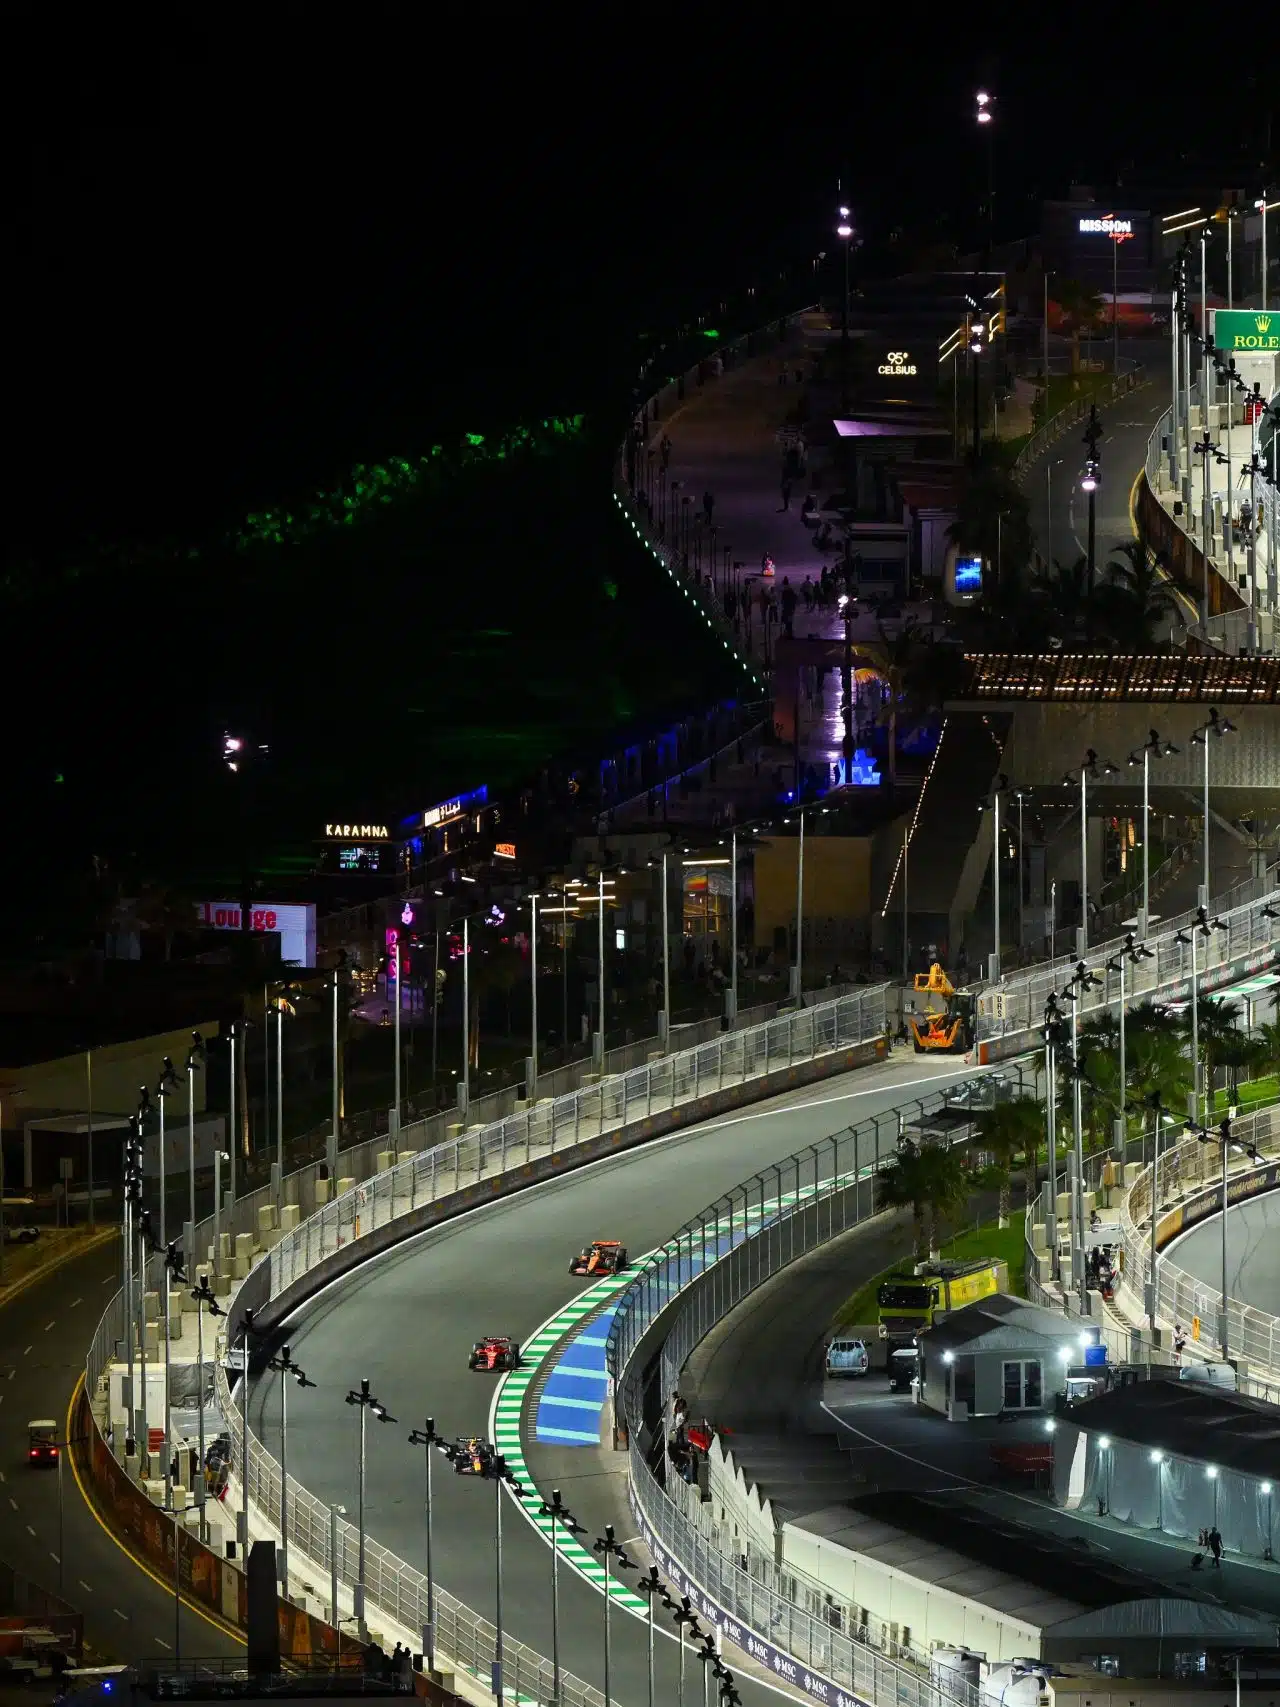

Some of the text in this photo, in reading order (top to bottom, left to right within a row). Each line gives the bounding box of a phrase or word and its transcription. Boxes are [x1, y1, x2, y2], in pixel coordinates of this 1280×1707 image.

[1079, 219, 1131, 233] MISSION
[878, 365, 917, 375] CELSIUS
[325, 824, 389, 838] KARAMNA
[729, 1622, 741, 1640] MSC
[753, 1641, 769, 1660] MSC
[781, 1659, 797, 1678] MSC
[811, 1678, 828, 1697] MSC
